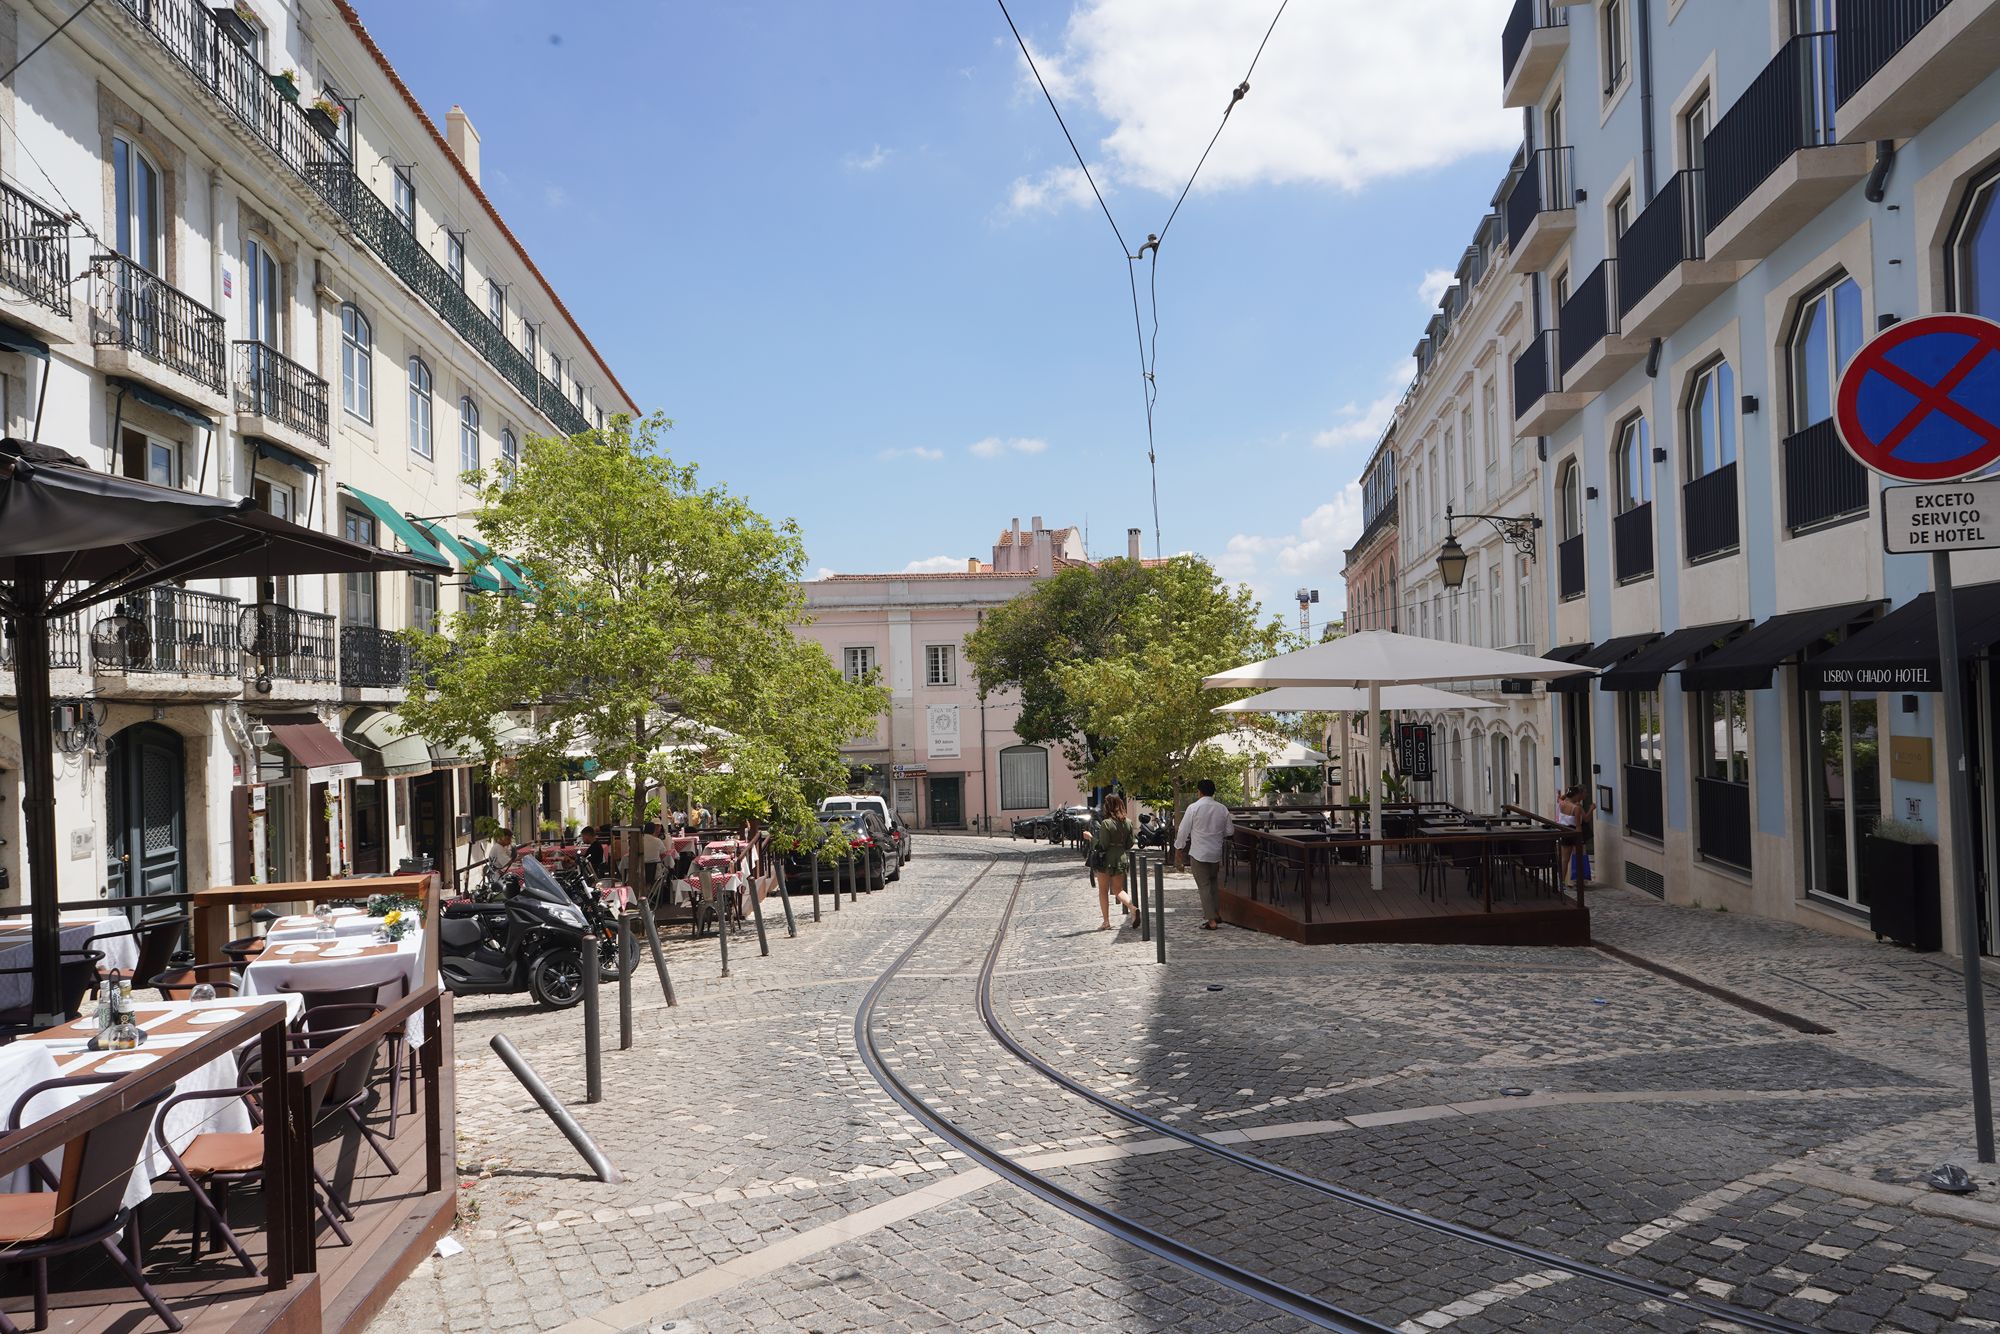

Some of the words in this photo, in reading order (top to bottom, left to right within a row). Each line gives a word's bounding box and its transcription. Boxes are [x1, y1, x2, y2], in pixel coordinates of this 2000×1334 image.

[1915, 492, 1975, 509] EXCETO
[1911, 509, 1980, 527] SERVIÇO
[1909, 531, 1929, 545] DE
[1934, 527, 1985, 543] HOTEL
[1823, 669, 1854, 683] LISBON
[1856, 669, 1892, 683] CHIADO
[1895, 668, 1931, 683] HOTEL
[1404, 739, 1412, 766] CRU
[1418, 742, 1426, 771] CRU
